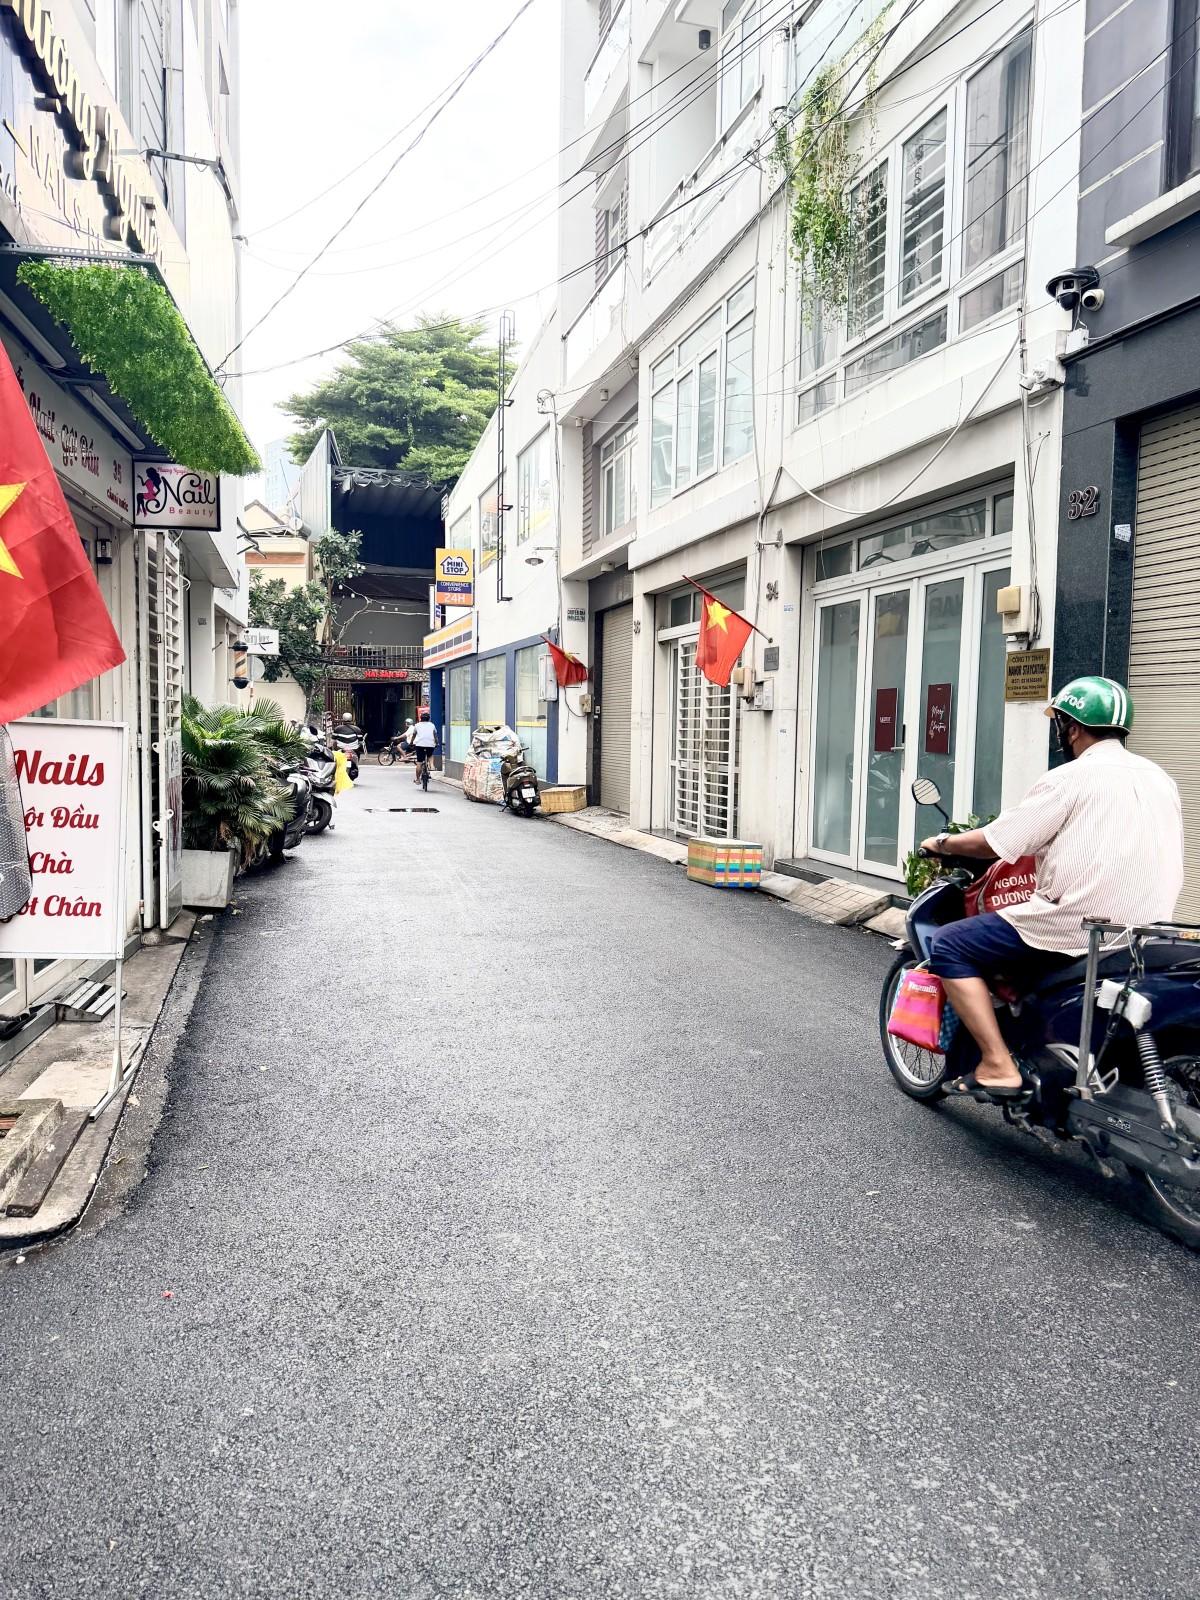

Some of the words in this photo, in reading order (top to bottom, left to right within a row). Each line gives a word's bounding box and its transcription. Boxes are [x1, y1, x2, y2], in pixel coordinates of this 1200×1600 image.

[145, 472, 216, 514] Nail
[1068, 485, 1099, 520] 32
[169, 506, 214, 517] Beauty
[444, 593, 466, 604] 24H
[13, 749, 105, 787] Nails
[24, 806, 45, 832] ội
[50, 803, 100, 829] Đầu
[30, 851, 74, 874] Chà
[994, 874, 1028, 890] NGOẠI
[43, 894, 102, 917] Chân
[991, 889, 1032, 907] DƯƠNG
